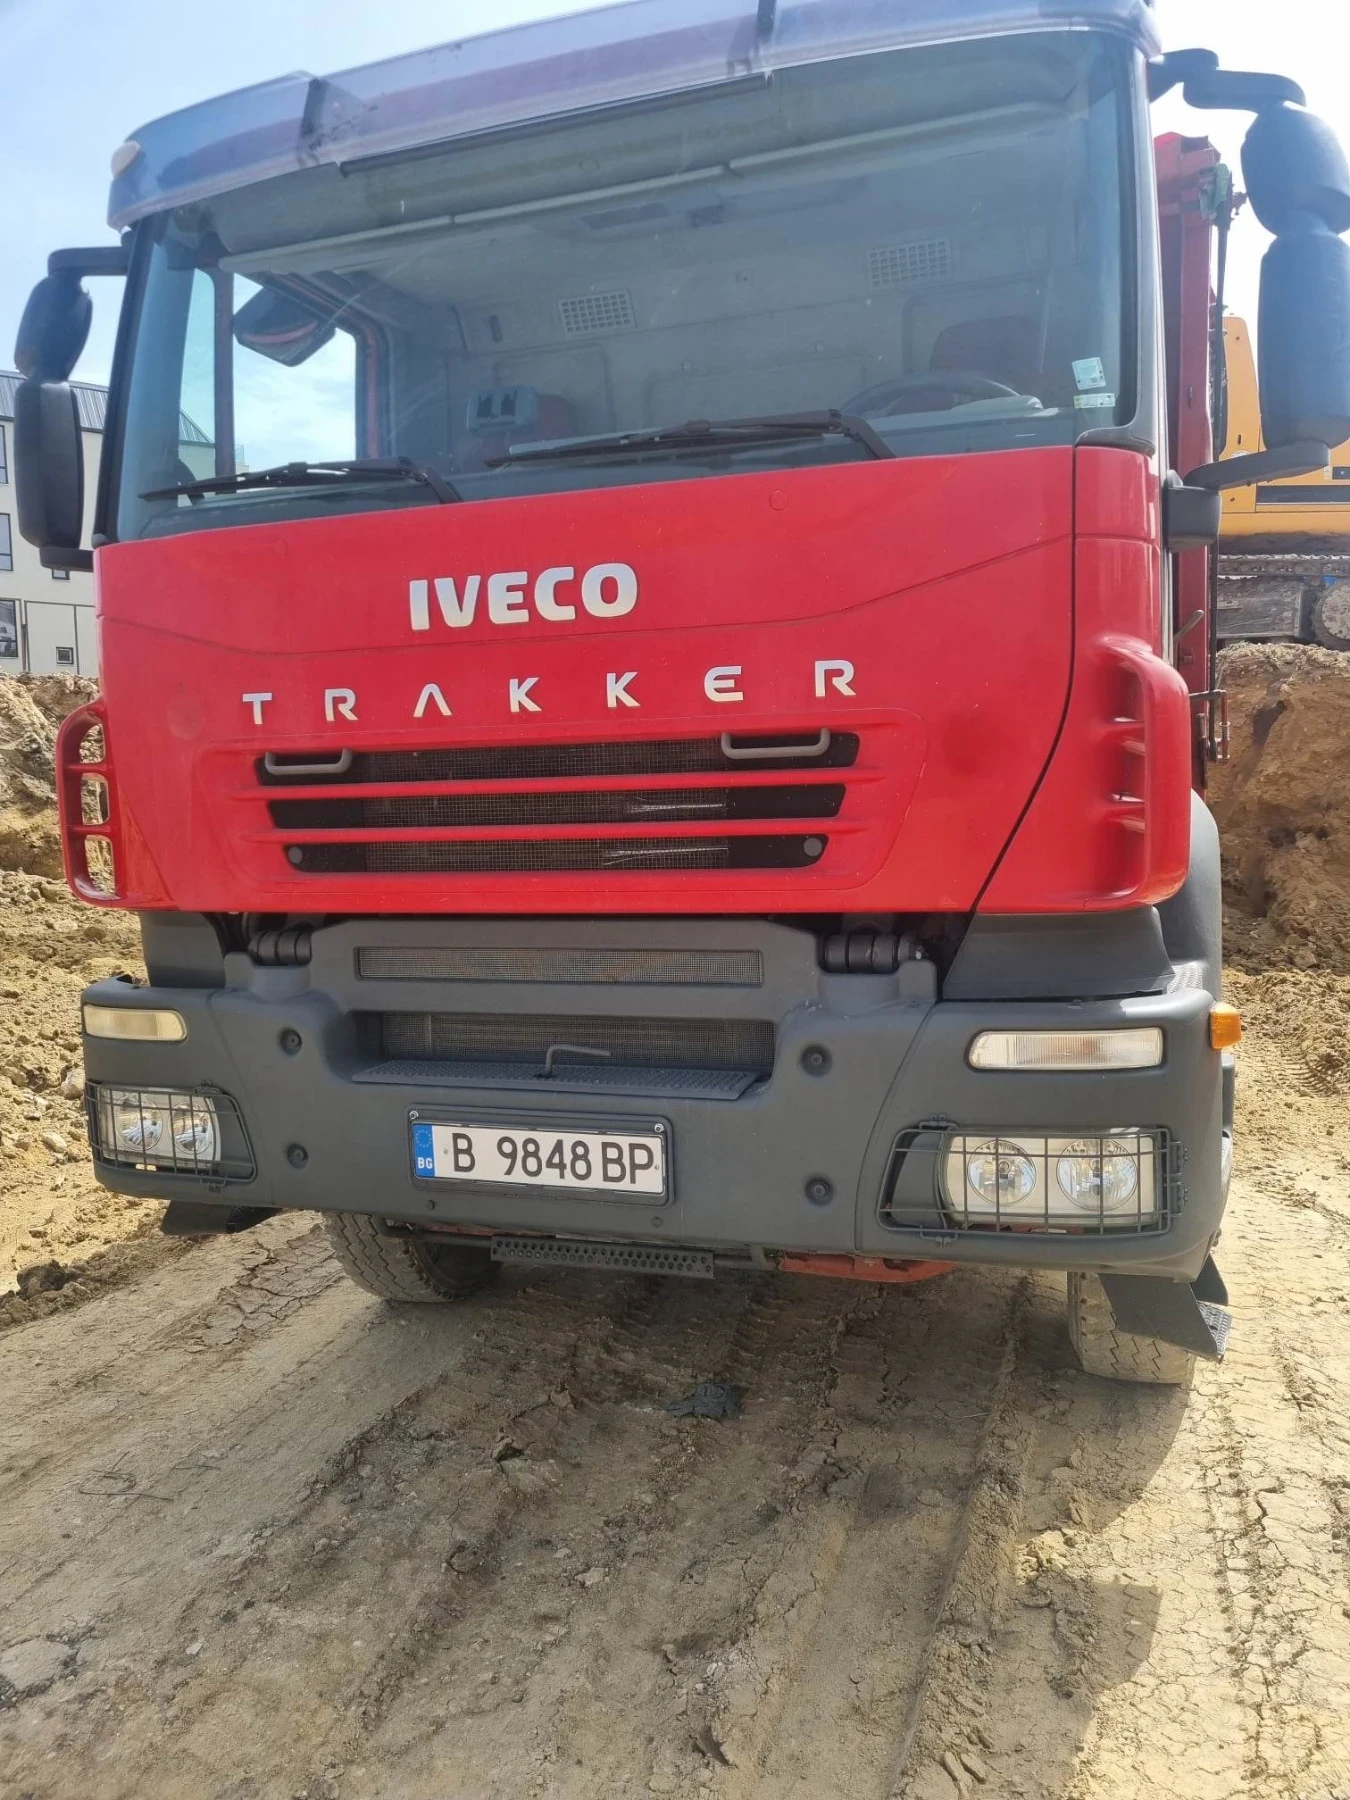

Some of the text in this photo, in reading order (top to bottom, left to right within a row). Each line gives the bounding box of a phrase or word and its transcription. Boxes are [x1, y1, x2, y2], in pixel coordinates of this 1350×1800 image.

[409, 562, 638, 631] IVECO
[242, 659, 857, 725] TRAKKER
[417, 1157, 433, 1170] BG
[451, 1132, 476, 1173] B
